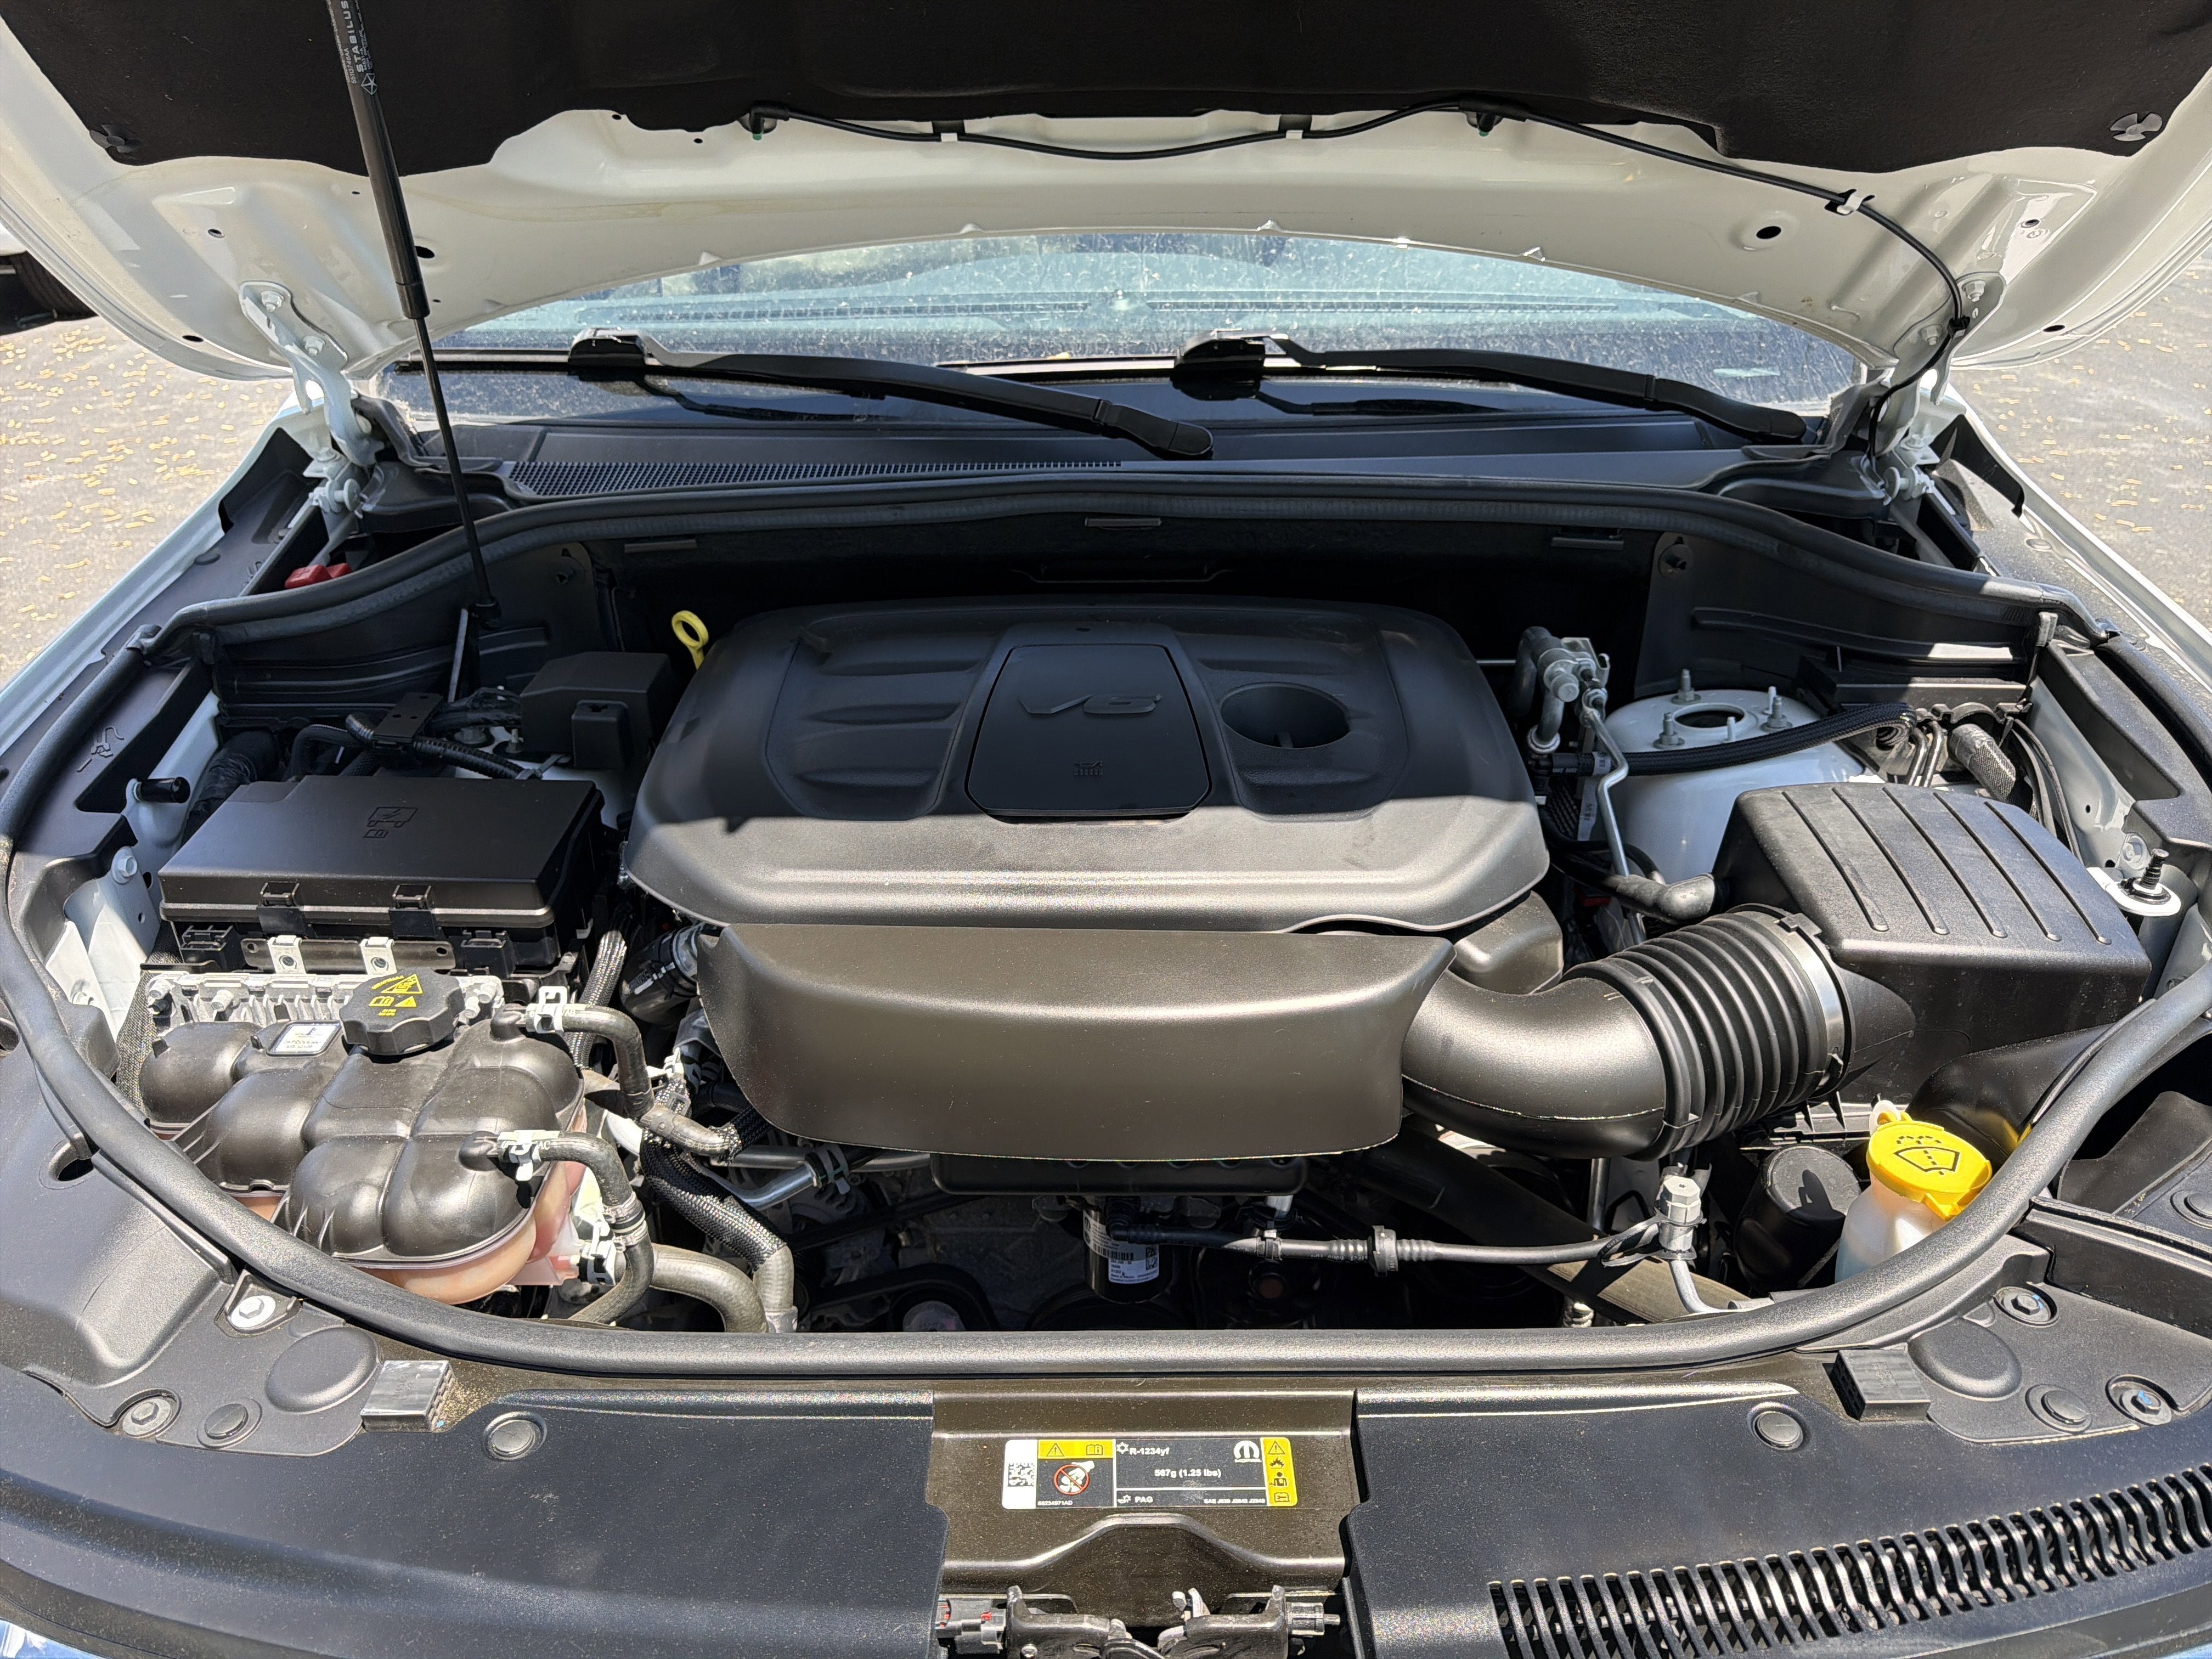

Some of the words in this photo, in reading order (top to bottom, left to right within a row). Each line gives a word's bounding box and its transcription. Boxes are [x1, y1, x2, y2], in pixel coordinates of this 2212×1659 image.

[341, 1, 364, 72] STABILUS
[1019, 693, 1162, 715] V6
[1129, 1447, 1170, 1456] R-1234yf
[1178, 1468, 1202, 1479] (1.25
[1204, 1468, 1222, 1479] lbs)
